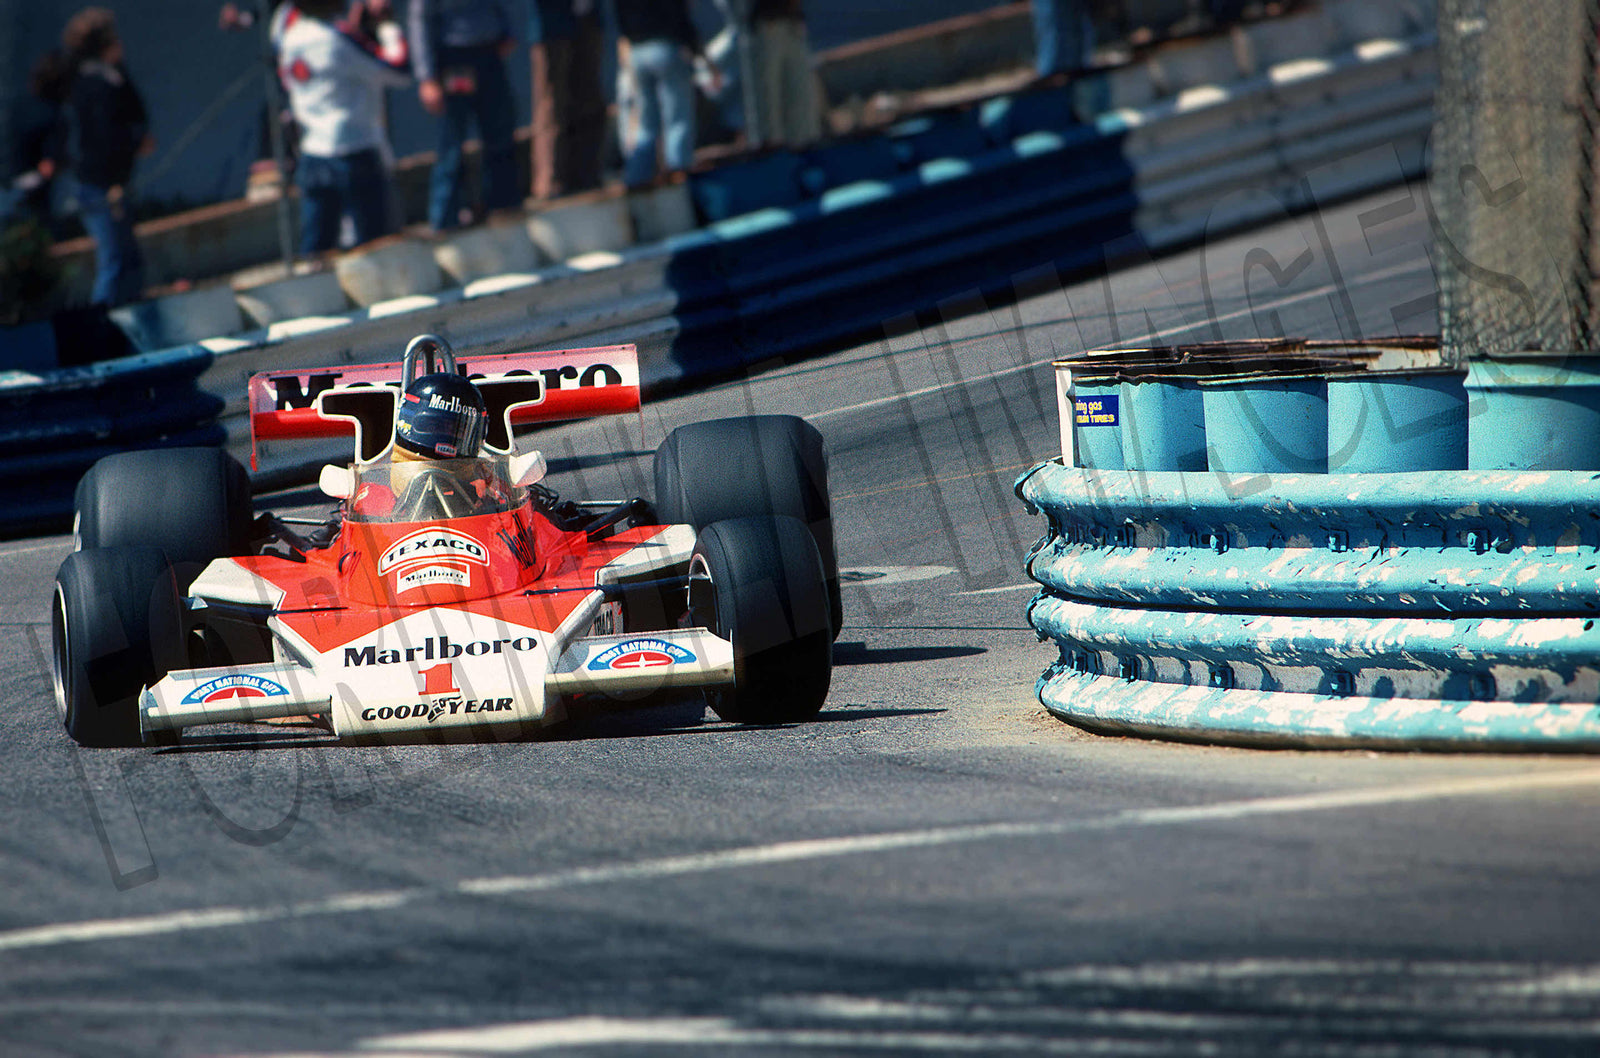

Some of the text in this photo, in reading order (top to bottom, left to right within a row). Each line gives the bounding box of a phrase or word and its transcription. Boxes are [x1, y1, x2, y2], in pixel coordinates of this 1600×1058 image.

[428, 393, 477, 417] Marlboro
[1090, 414, 1115, 424] TIRES
[386, 538, 483, 563] TEXACO
[405, 569, 464, 582] Marlboro
[344, 635, 538, 668] Marlboro
[621, 640, 666, 652] NATIONAL
[214, 676, 260, 687] NATIONAL
[260, 681, 282, 694] CITY
[418, 662, 461, 696] 1
